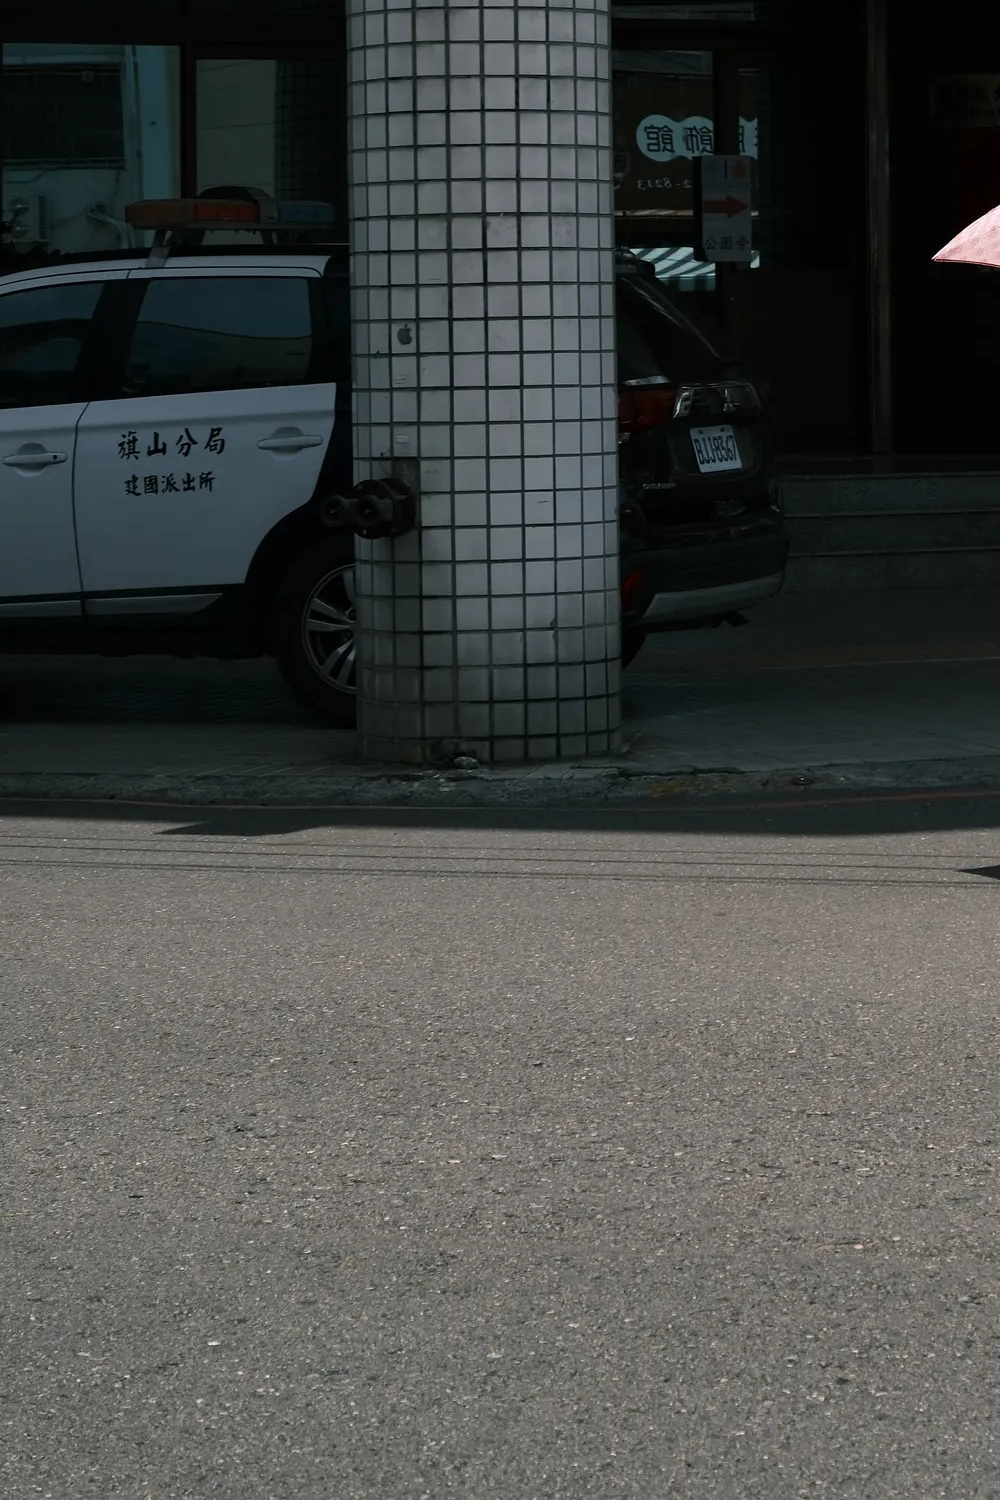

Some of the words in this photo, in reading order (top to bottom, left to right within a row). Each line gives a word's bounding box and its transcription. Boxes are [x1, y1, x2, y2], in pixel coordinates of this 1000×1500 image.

[117, 427, 226, 461] 旗山分局
[123, 471, 216, 497] 建國派出所
